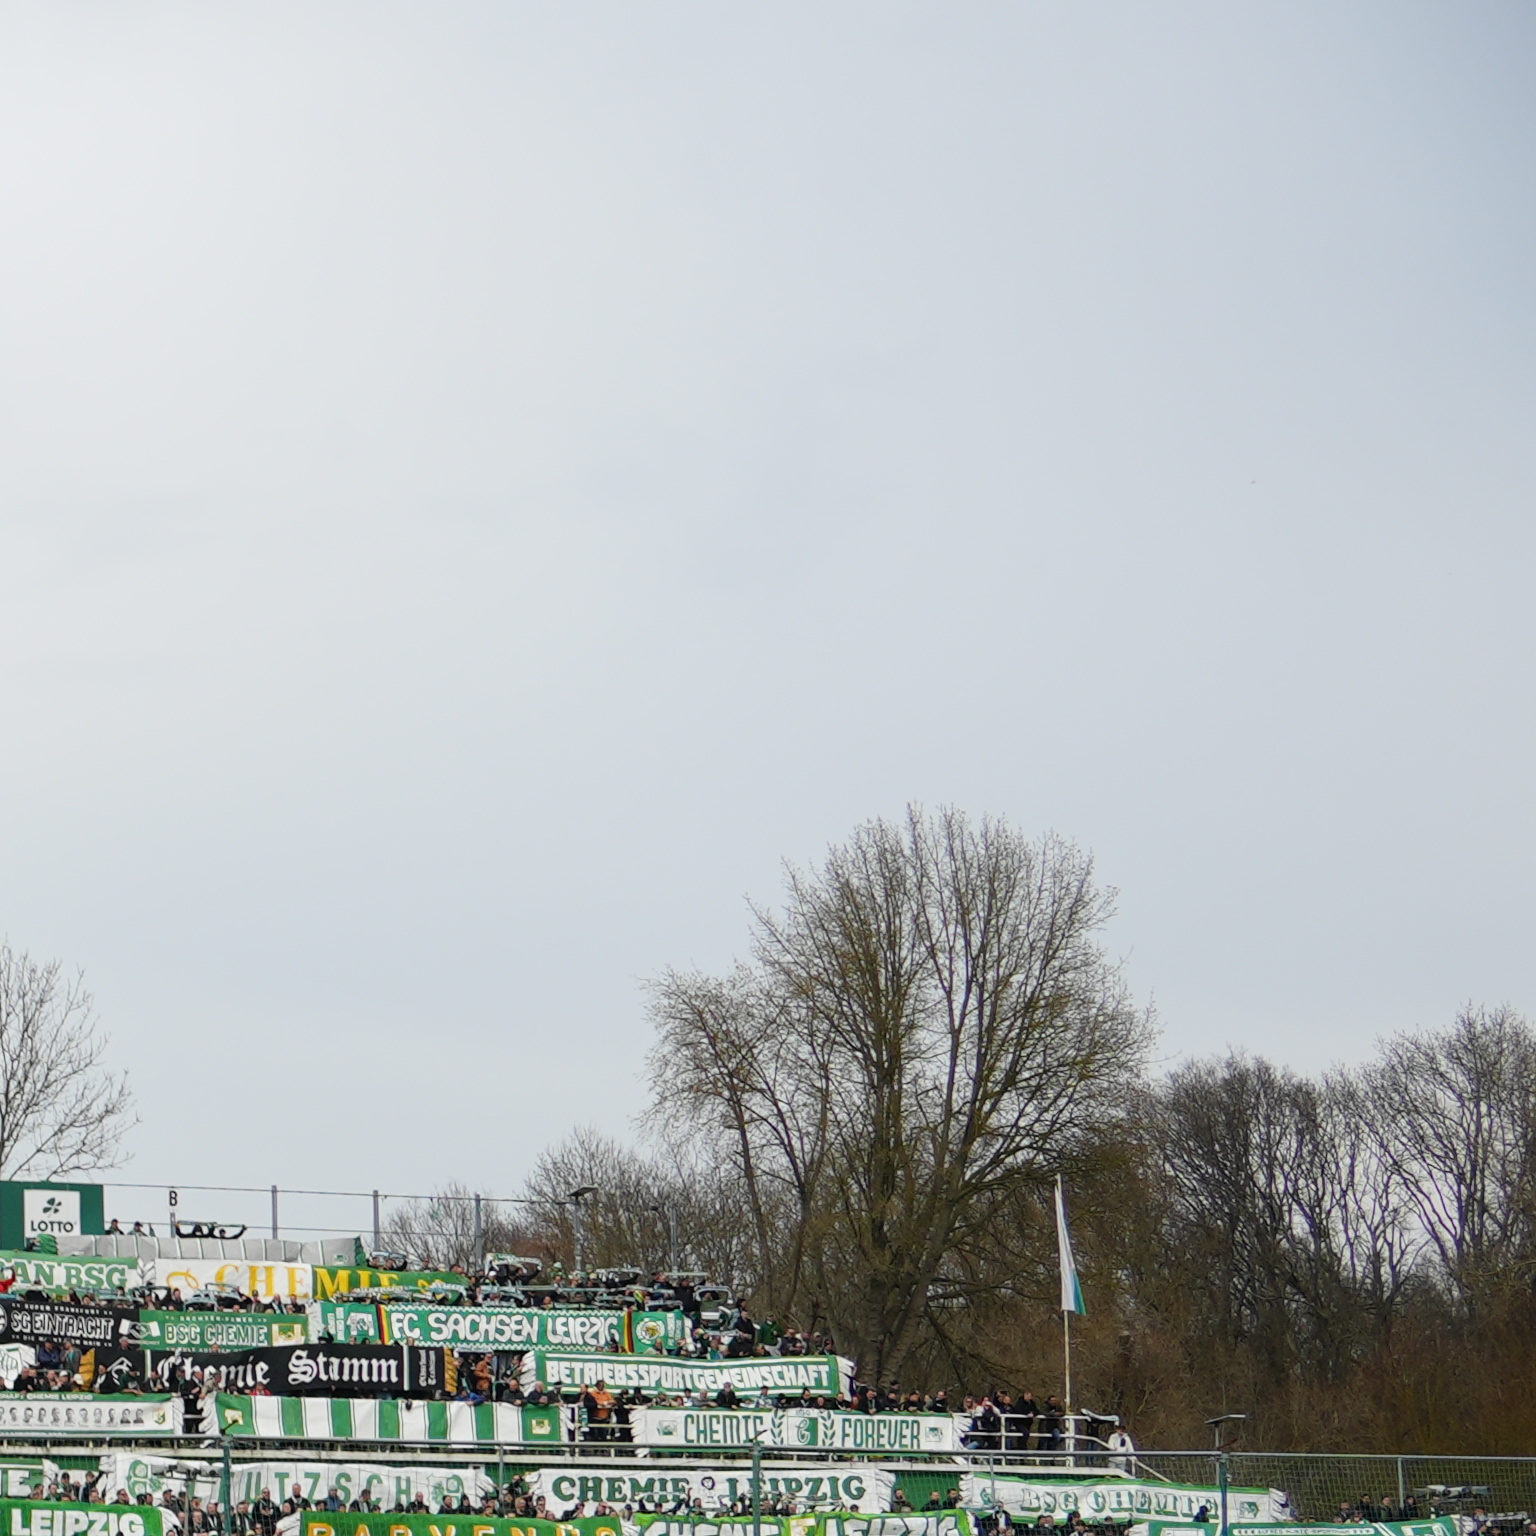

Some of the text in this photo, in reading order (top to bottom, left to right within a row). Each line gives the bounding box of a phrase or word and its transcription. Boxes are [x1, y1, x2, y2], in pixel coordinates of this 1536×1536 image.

[169, 1190, 178, 1206] B
[30, 1220, 74, 1234] LOTTO
[63, 1262, 127, 1292] BSG
[32, 1311, 115, 1340] EINTRACHT
[165, 1323, 268, 1347] BSG CHEMIE
[428, 1312, 539, 1343] SACHSEN
[546, 1314, 619, 1346] LEIPZIG
[287, 1350, 400, 1386] Stamm
[546, 1359, 830, 1390] BETRIEBSSPORTGEMEINSCHAFT
[684, 1413, 921, 1450] CHEMIE FOREVER
[552, 1475, 866, 1503] CHEMIE LEIPZIG
[1020, 1487, 1220, 1519] BSG CHEMIE
